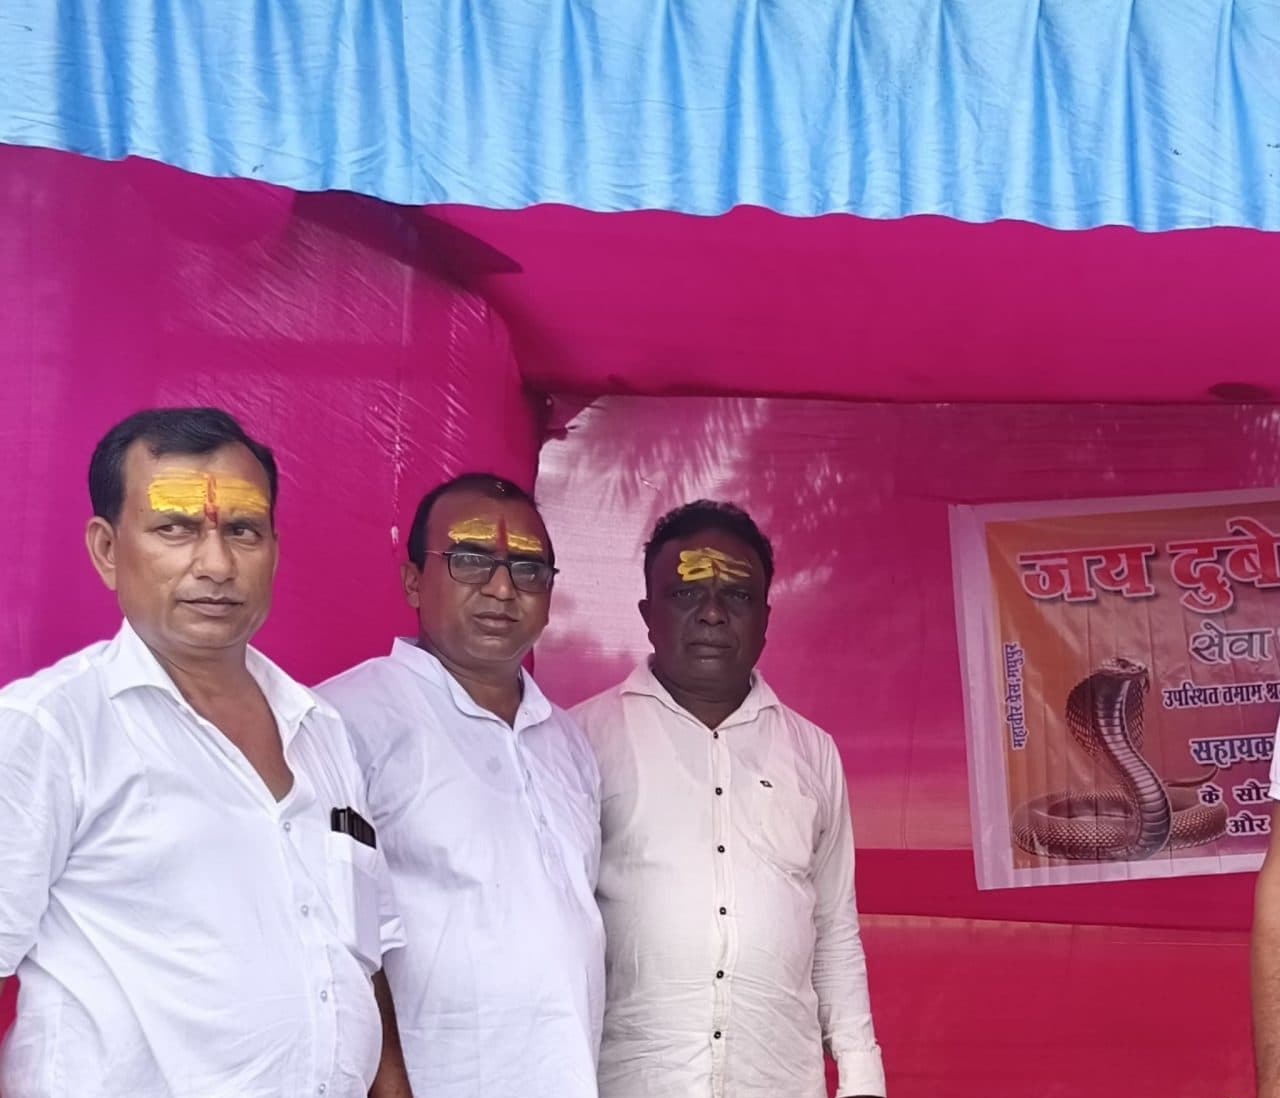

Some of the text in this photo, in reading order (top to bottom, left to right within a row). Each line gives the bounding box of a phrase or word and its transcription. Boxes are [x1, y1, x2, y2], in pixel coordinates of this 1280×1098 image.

[1020, 543, 1155, 601] जय
[1190, 619, 1272, 664] सेवा
[1163, 681, 1219, 707] उपस्थित
[1222, 682, 1263, 704] तमाम
[1199, 782, 1222, 807] के
[1227, 811, 1270, 836] और
